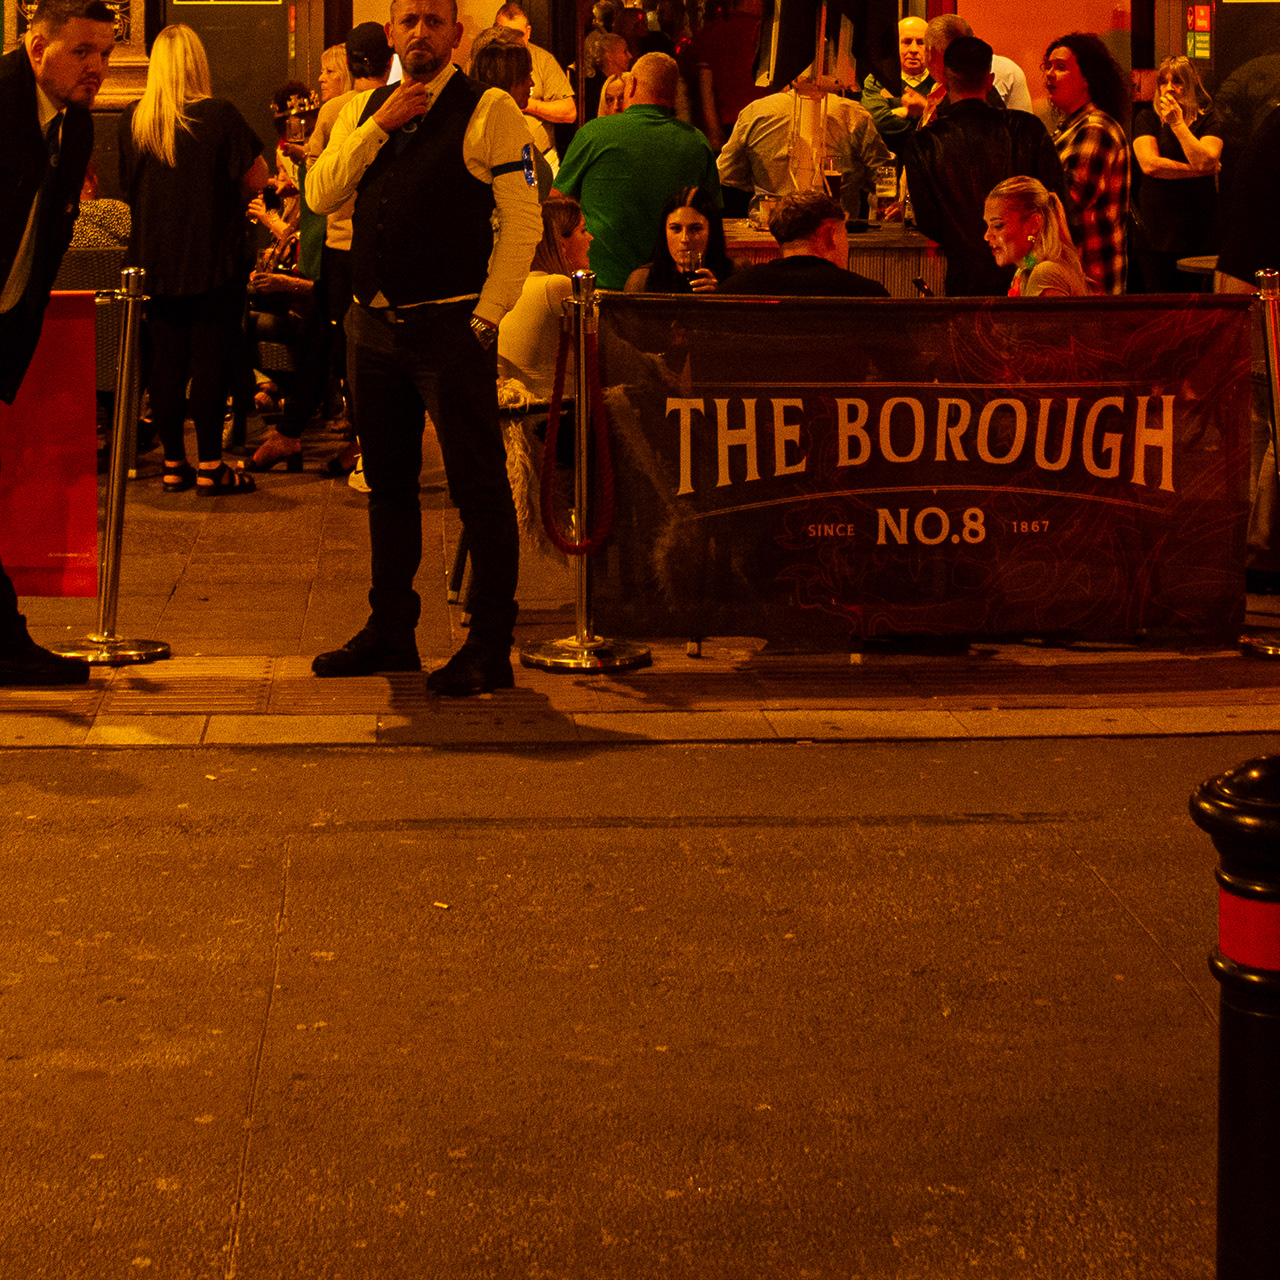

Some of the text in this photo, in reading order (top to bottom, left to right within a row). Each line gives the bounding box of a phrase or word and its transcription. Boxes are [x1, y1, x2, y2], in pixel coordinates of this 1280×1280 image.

[665, 395, 1177, 496] THE BOROUGH
[808, 506, 1051, 546] SINCE NO.8 1867
